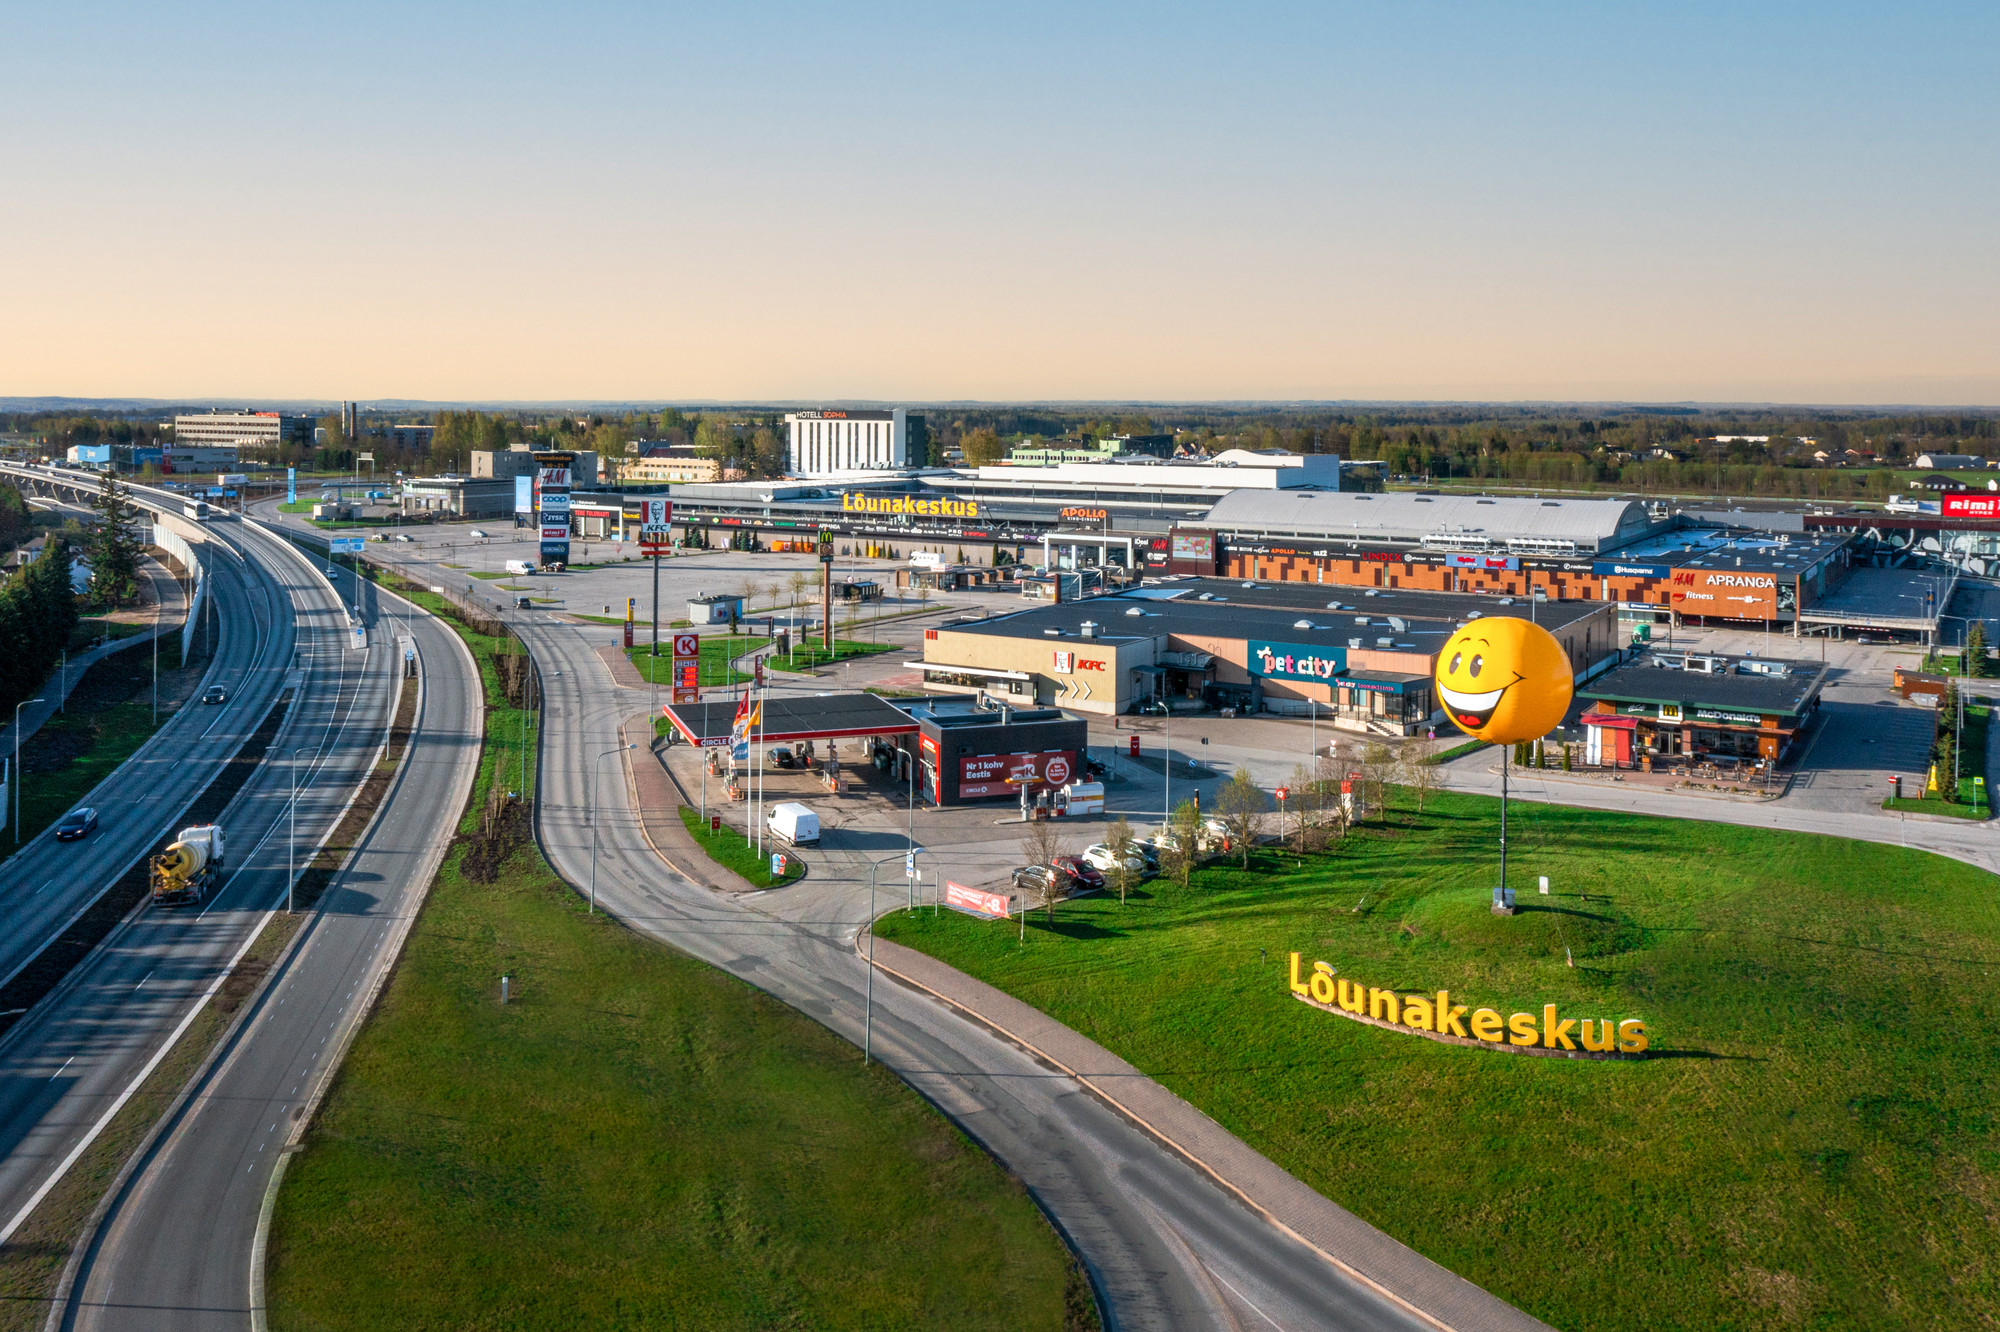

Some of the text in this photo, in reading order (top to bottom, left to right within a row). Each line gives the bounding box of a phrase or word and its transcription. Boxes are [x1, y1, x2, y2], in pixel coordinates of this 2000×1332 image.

[823, 411, 847, 419] SOPHIA
[542, 469, 566, 485] H&M
[1061, 508, 1107, 519] APOLLO
[1362, 552, 1402, 562] LINDEX
[1621, 567, 1653, 575] Husqvarna
[1673, 573, 1695, 586] H&M
[1706, 574, 1775, 588] APRANGA
[1686, 591, 1715, 600] fitness
[1077, 659, 1106, 671] KFC
[1263, 654, 1336, 679] pet city
[1696, 709, 1761, 723] McDonald's
[984, 761, 1004, 769] kohv
[966, 771, 991, 779] Eestis
[1289, 951, 1649, 1054] Lõunakeskus
